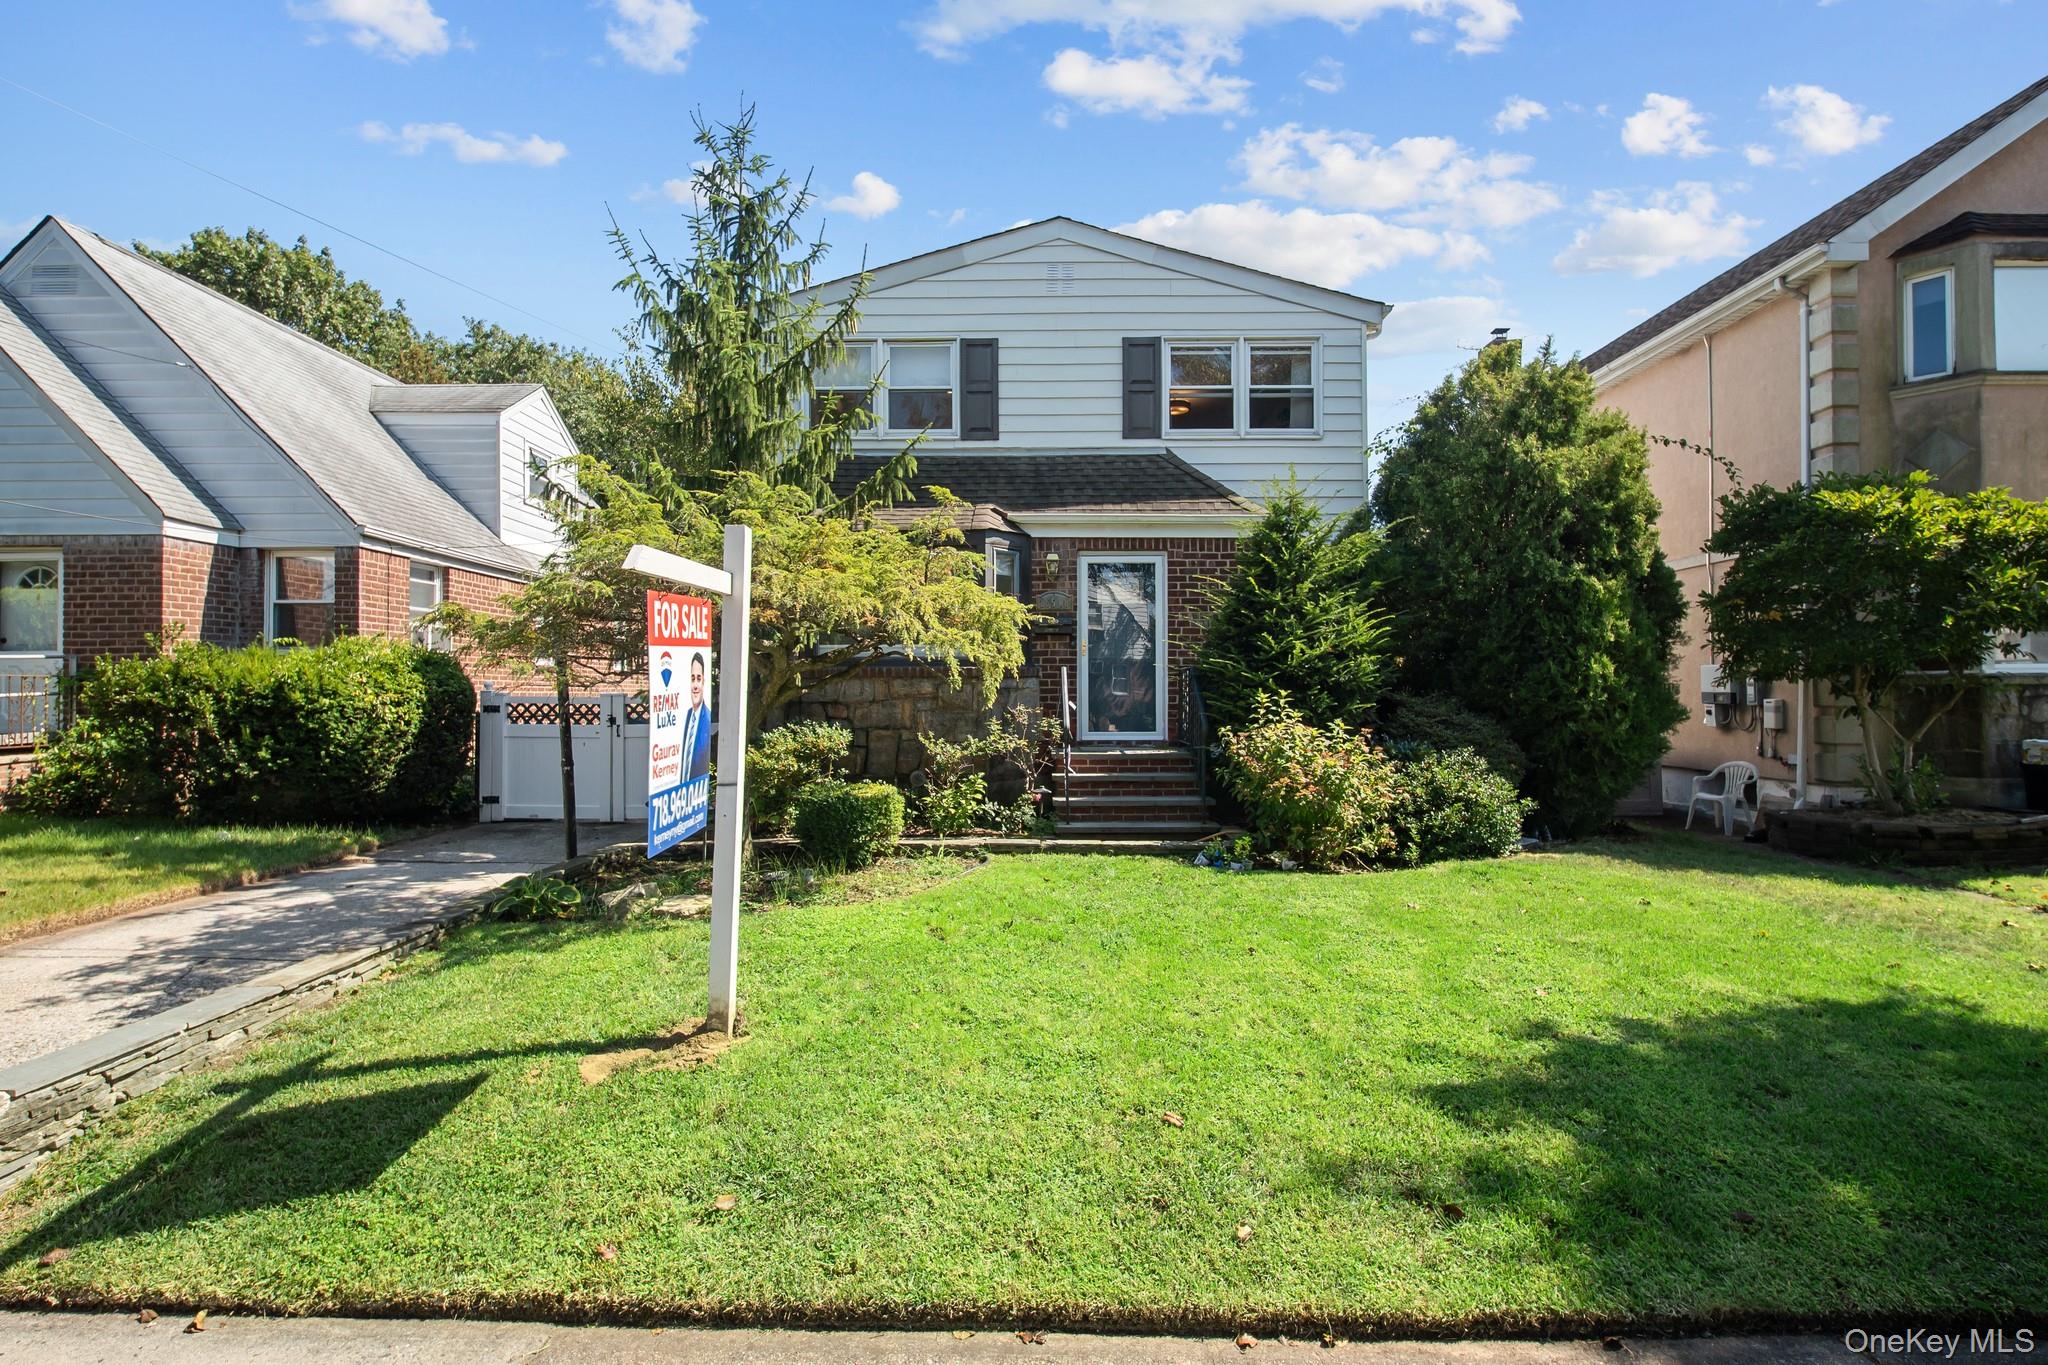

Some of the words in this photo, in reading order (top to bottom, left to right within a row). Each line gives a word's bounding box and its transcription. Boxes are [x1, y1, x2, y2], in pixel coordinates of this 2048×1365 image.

[653, 600, 680, 638] FOR
[681, 604, 708, 640] SALE
[653, 692, 679, 712] RE/MAX
[652, 743, 680, 762] Gaurav
[652, 762, 679, 779] Kerney
[652, 778, 708, 831] 718.969.0444
